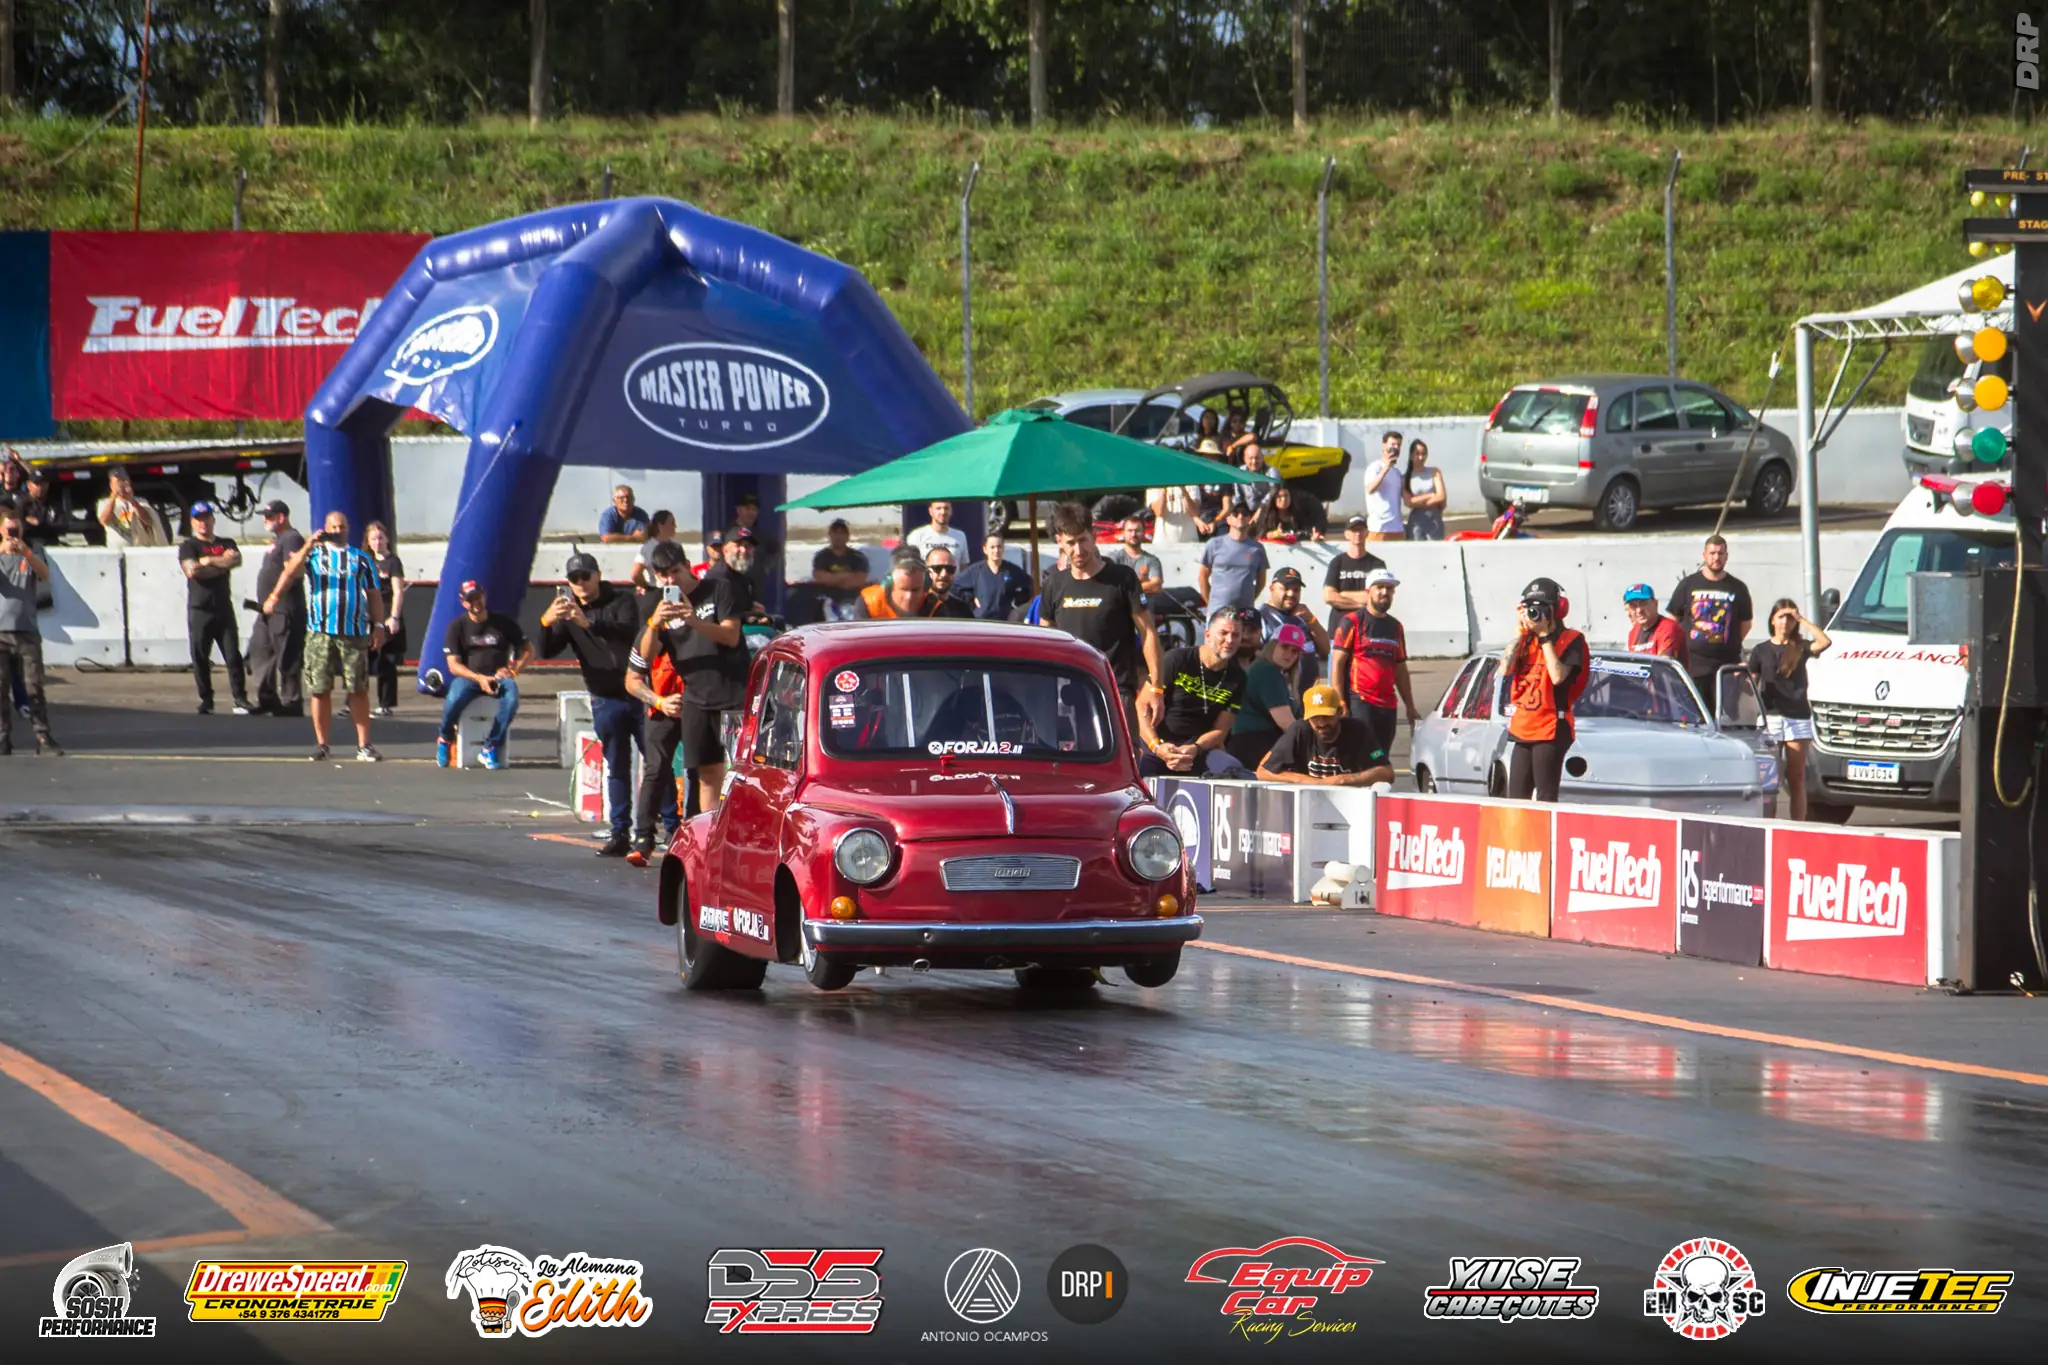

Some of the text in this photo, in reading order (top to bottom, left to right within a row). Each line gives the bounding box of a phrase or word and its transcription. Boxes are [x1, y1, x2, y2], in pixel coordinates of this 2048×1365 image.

[639, 360, 812, 411] MASTER POWER
[679, 418, 777, 432] TURBO
[1213, 793, 1232, 862] RS
[1388, 820, 1466, 879] FuelTech
[1485, 844, 1543, 895] VELOPARK
[1569, 837, 1662, 899] FuelTech
[1681, 848, 1700, 909] RS
[1787, 857, 1908, 929] FuelTech
